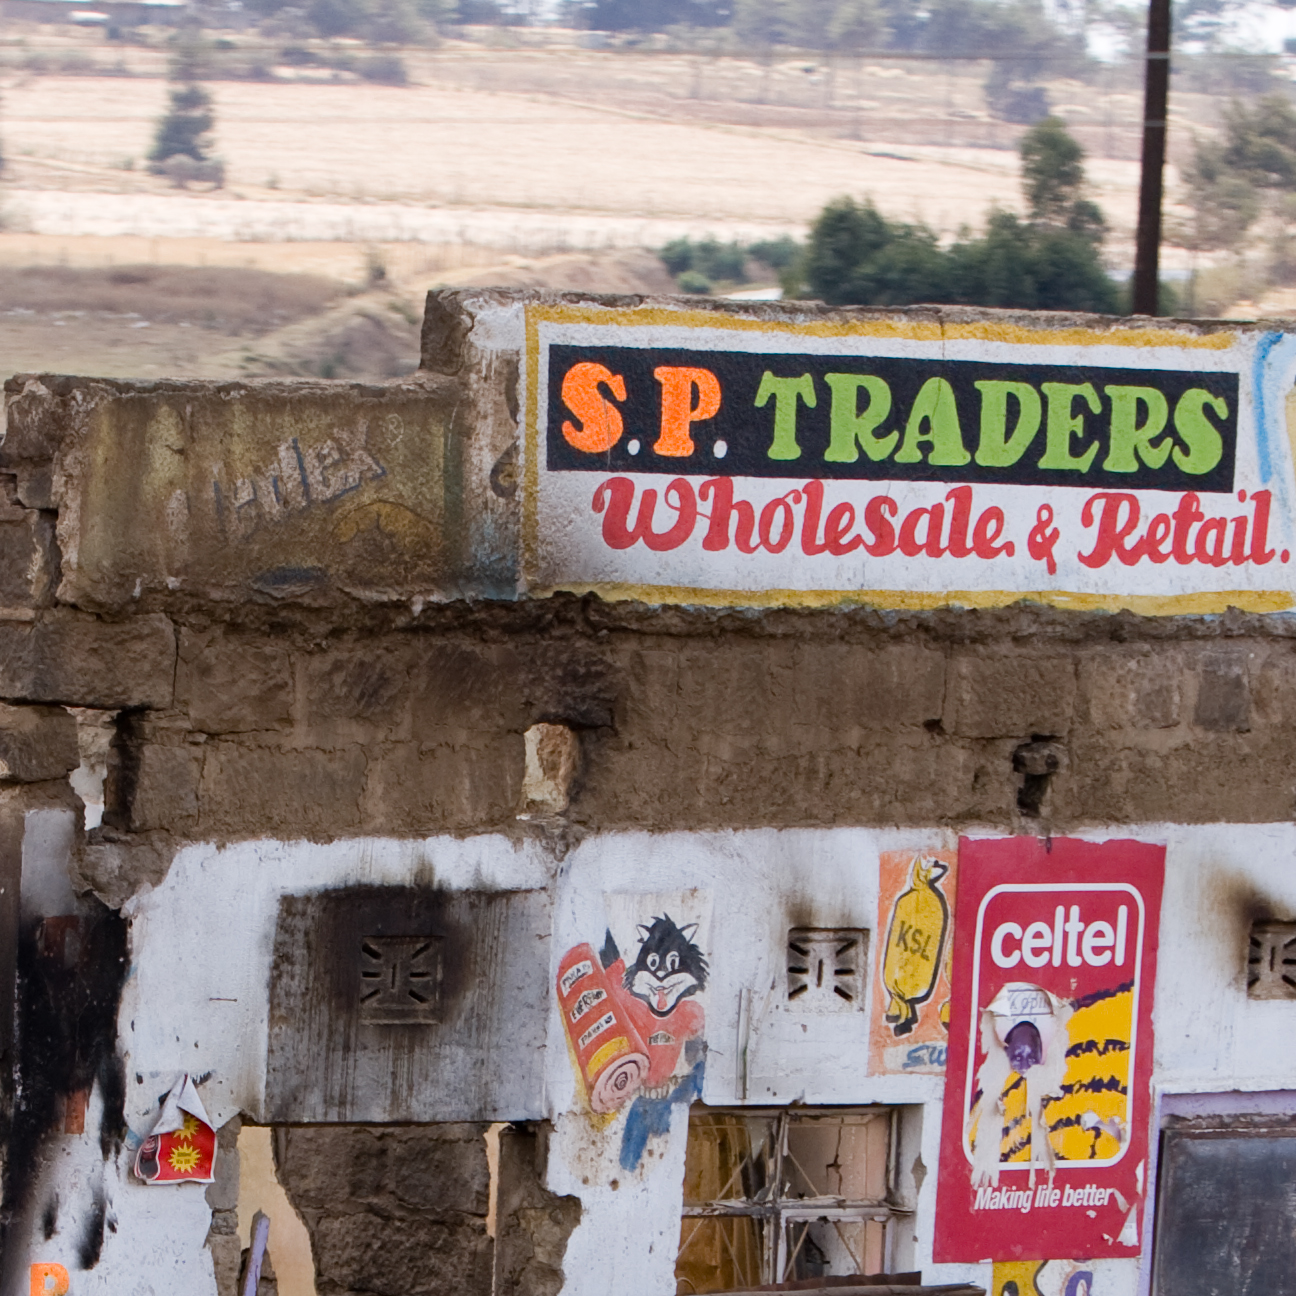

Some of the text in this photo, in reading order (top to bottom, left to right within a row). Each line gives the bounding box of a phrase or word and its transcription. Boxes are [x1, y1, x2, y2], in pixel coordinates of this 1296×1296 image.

[560, 361, 1230, 474] S.P. TRADERS
[592, 476, 1291, 575] Wholesale & Retail.
[895, 919, 932, 961] KSL
[990, 904, 1128, 967] celtel
[974, 1183, 1115, 1213] Making life better
